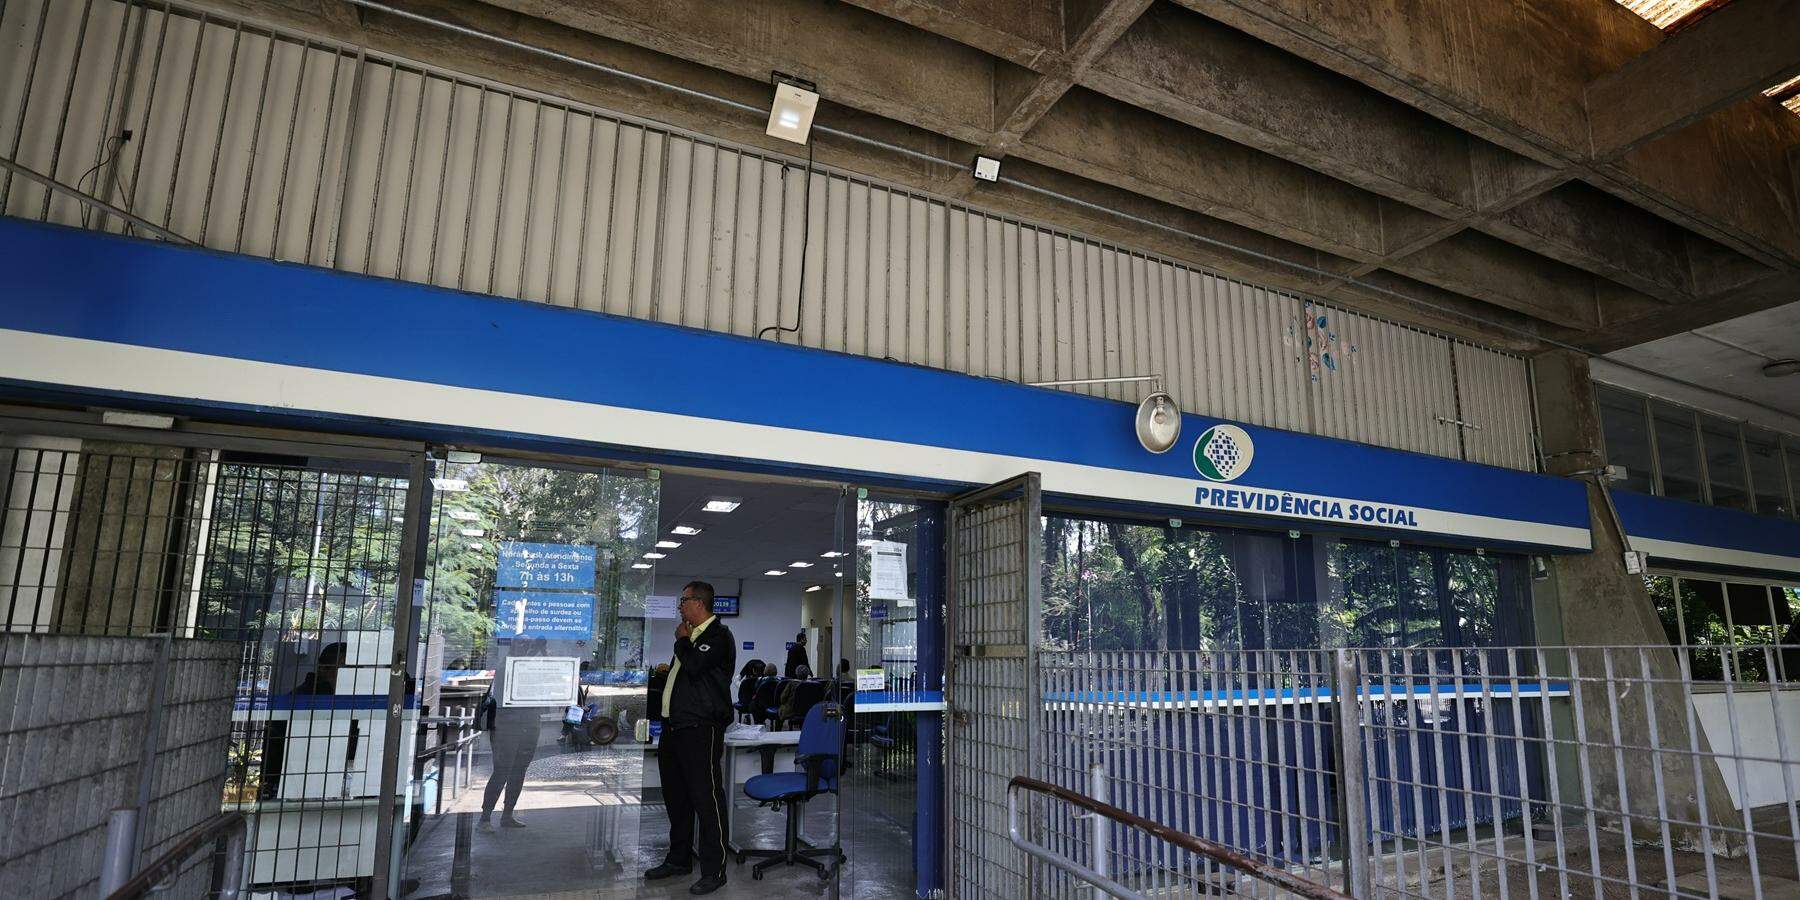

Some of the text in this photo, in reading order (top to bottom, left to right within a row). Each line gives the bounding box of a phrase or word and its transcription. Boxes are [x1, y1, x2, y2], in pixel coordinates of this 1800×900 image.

[1194, 486, 1418, 527] PREVIDÊNCIA SOCIAL
[515, 561, 549, 570] Segunda
[558, 562, 579, 570] Sexta
[520, 571, 574, 582] 7h às 13h
[548, 601, 575, 609] pessoas
[507, 616, 550, 624] maa-passo
[554, 624, 588, 632] alternativa
